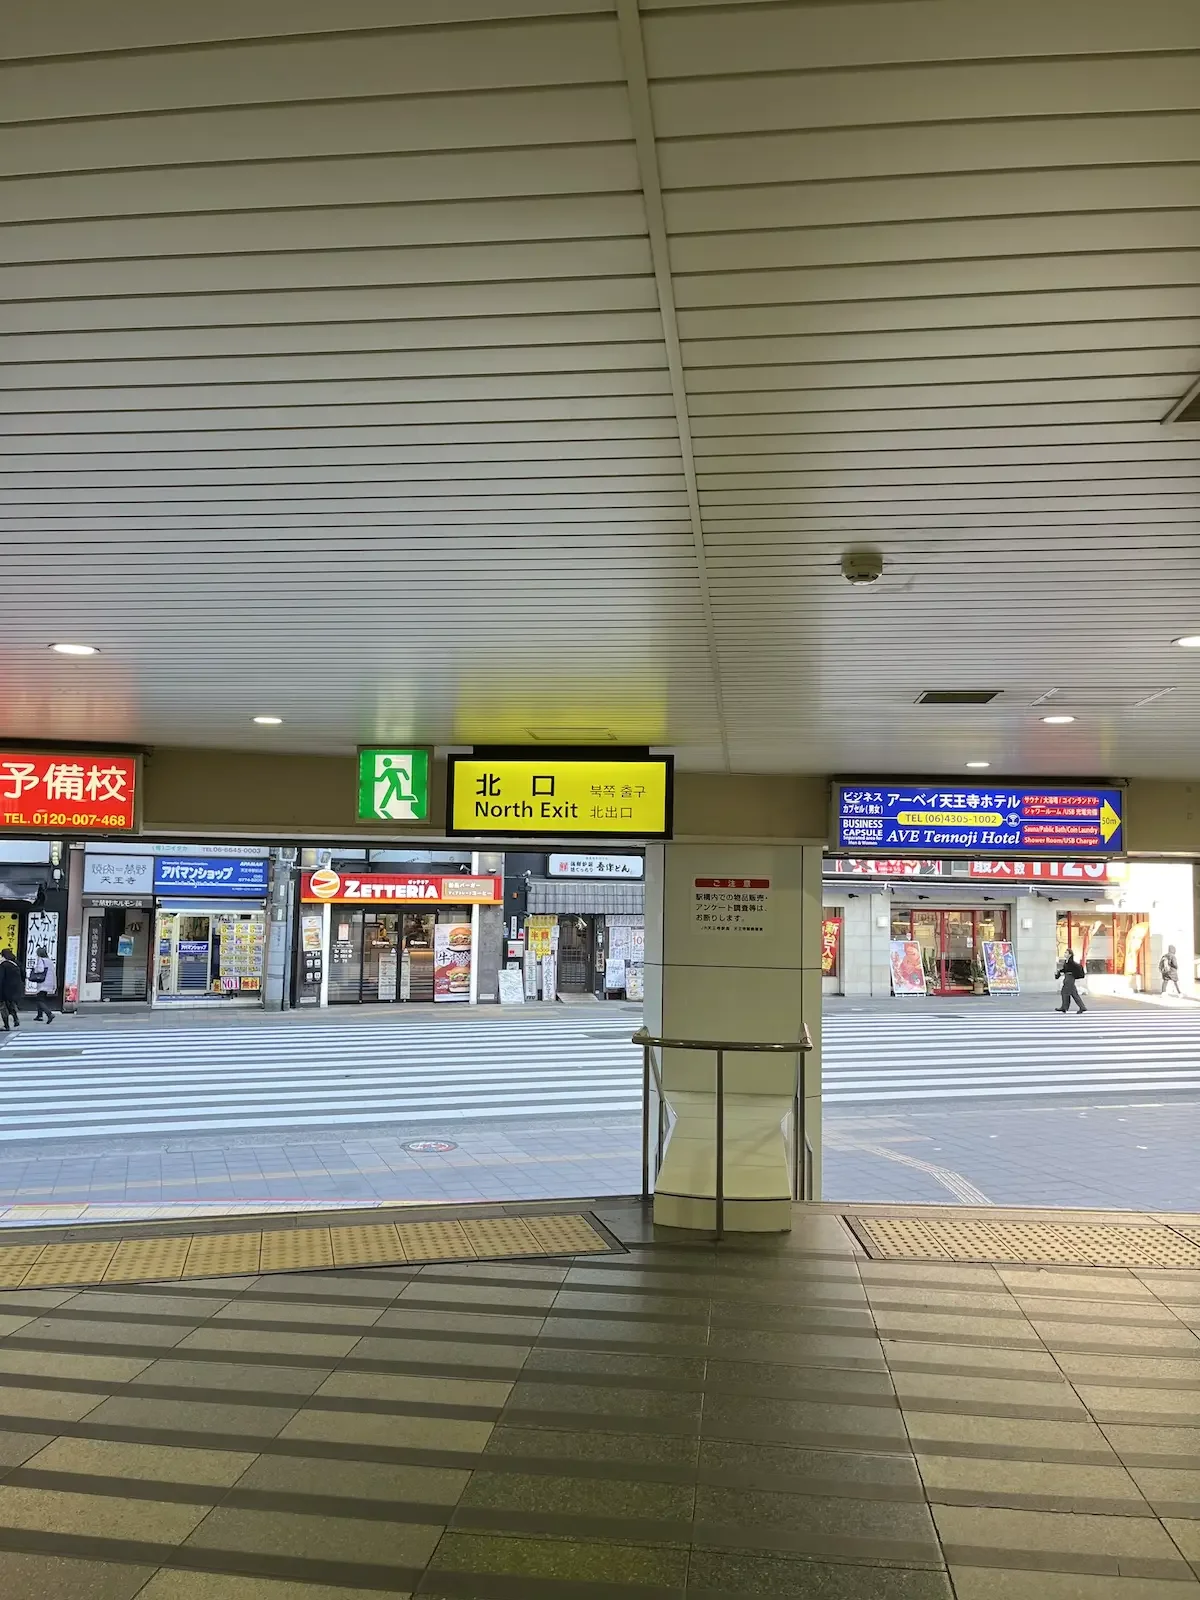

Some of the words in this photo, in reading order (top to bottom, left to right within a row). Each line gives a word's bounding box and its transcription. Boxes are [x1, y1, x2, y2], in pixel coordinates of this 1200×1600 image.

[0, 762, 127, 802] 予備校
[590, 785, 616, 797] 북쪽
[620, 785, 647, 798] 출구
[843, 792, 882, 802] ビジネス
[887, 793, 1021, 809] アーベイ天王寺ホテル
[475, 801, 533, 818] North
[540, 802, 578, 818] Exit
[590, 807, 633, 819] 北出口
[4, 813, 31, 824] TEL.
[33, 813, 126, 826] 0120-007-468
[843, 819, 883, 828] BUSINESS
[905, 814, 922, 823] TEL
[925, 813, 997, 824] (06)4305-1002
[1102, 816, 1117, 825] 50m
[843, 829, 883, 837] CAPSULE
[886, 829, 920, 842] AVE
[924, 830, 978, 847] Tennoji
[980, 831, 1020, 844] Hotel
[161, 866, 233, 880] アパマンショップ
[100, 876, 137, 885] 天王寺
[713, 880, 751, 888] ご注意
[343, 880, 438, 899] ZETTERIA
